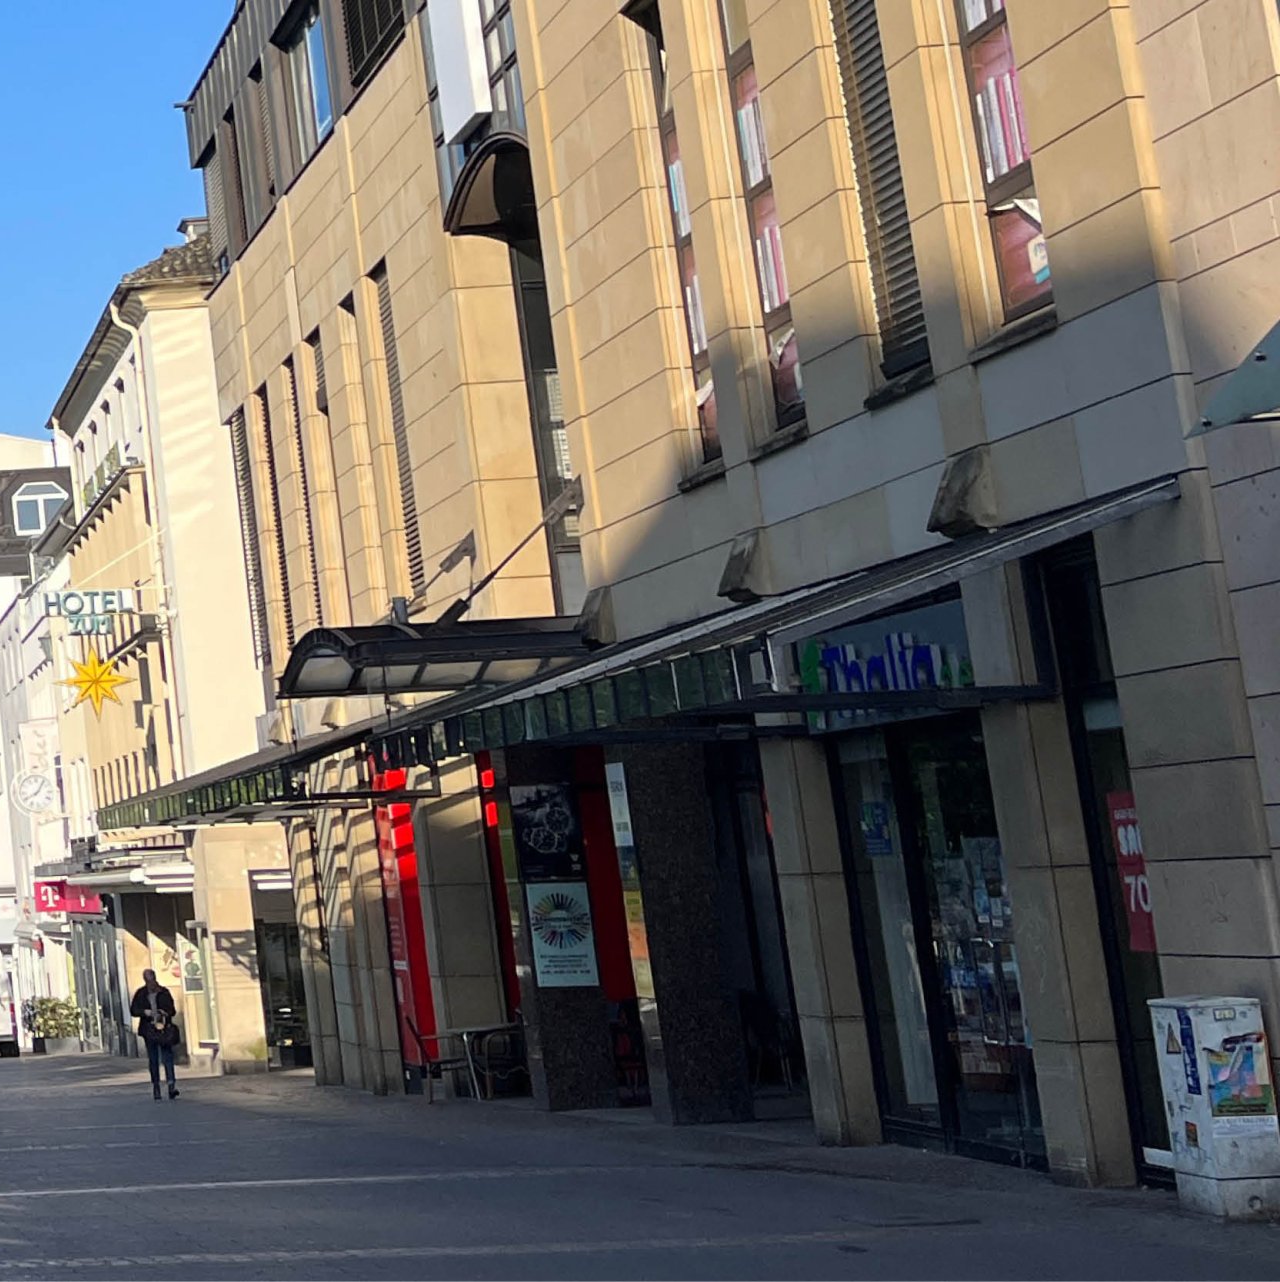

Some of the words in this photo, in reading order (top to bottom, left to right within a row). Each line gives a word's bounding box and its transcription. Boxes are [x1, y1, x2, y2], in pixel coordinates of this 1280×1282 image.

[43, 590, 133, 616] HOTEL
[68, 615, 113, 635] ZUM
[821, 632, 940, 694] Thalia
